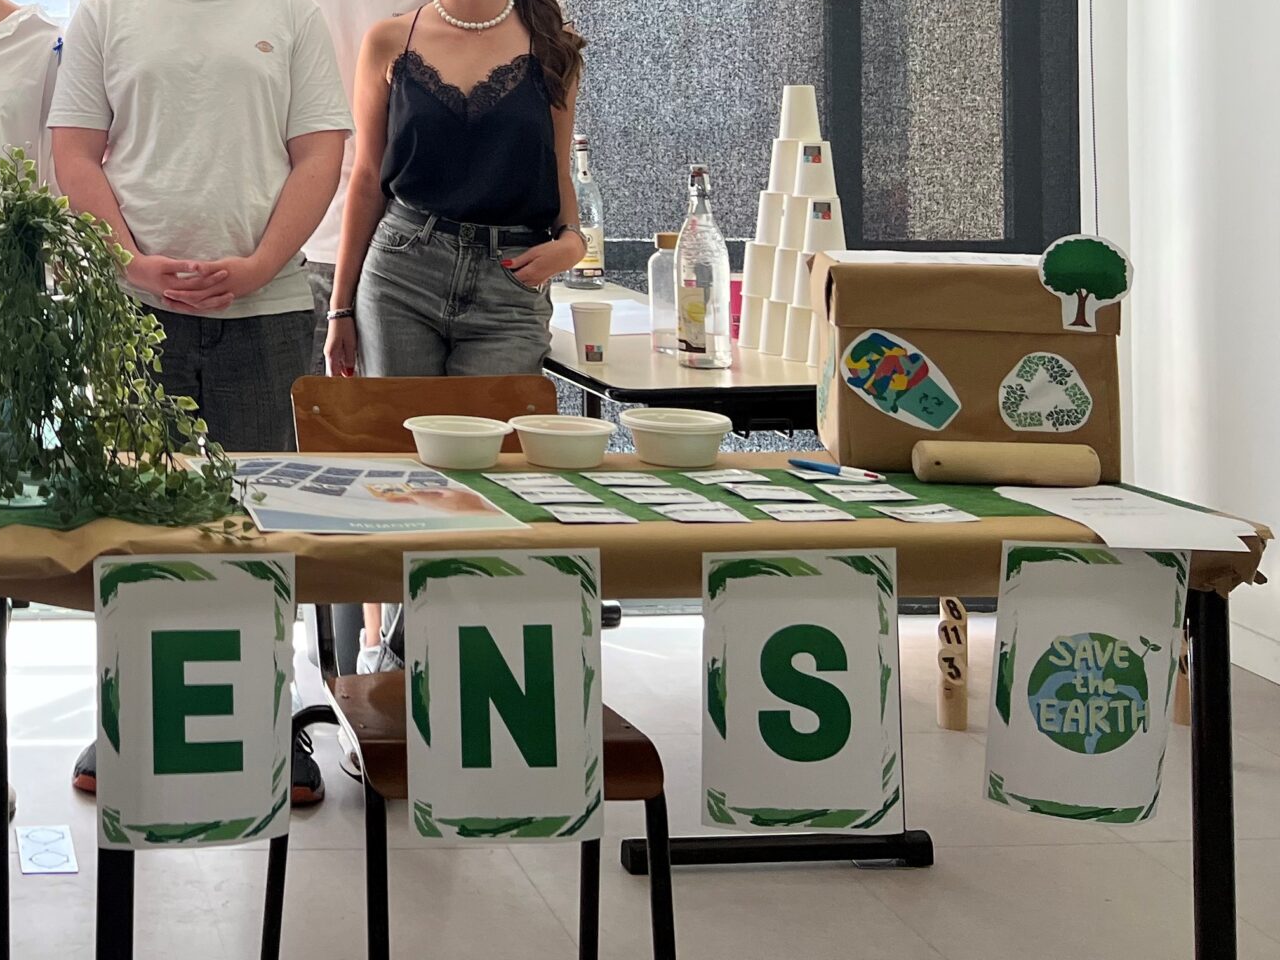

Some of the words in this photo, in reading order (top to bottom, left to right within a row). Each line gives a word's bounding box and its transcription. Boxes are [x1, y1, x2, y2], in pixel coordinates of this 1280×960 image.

[945, 599, 962, 621] 8
[940, 625, 962, 645] 11
[1048, 640, 1130, 670] SAVE
[942, 656, 961, 680] 3
[1072, 672, 1118, 696] the
[1038, 699, 1151, 734] EARTH
